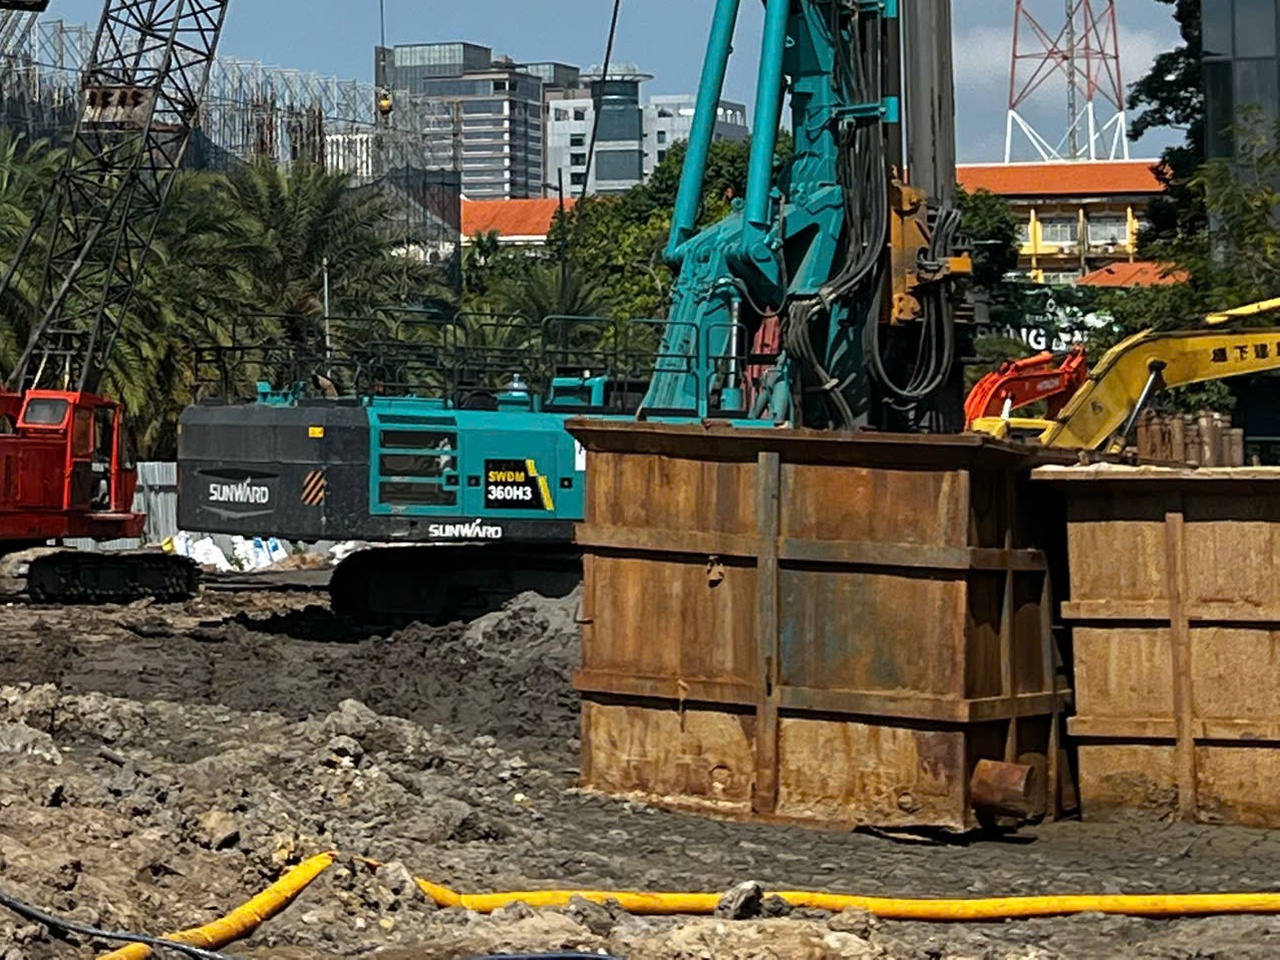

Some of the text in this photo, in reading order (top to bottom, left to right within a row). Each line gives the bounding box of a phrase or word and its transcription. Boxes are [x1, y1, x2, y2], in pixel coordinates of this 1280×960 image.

[488, 470, 525, 482] SWDM
[209, 476, 269, 504] SUNWARD
[487, 485, 532, 500] 360H3
[428, 518, 502, 538] SUNWARD
